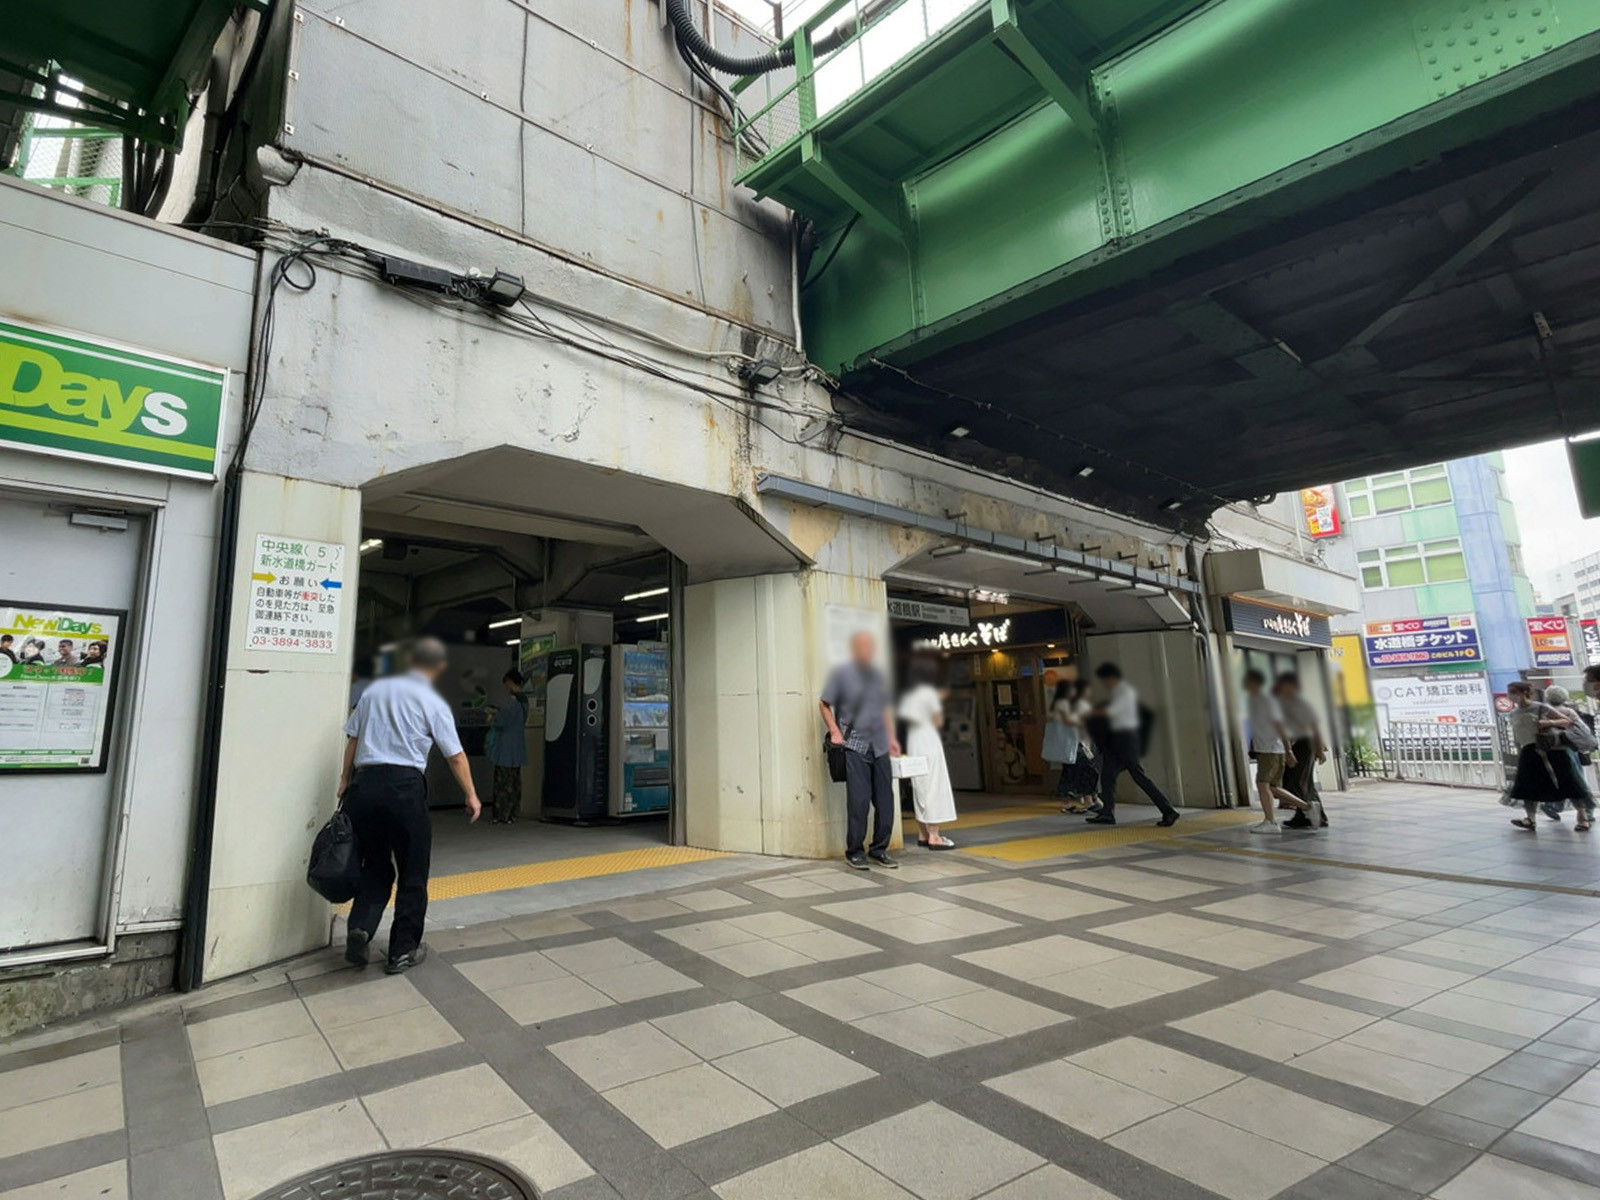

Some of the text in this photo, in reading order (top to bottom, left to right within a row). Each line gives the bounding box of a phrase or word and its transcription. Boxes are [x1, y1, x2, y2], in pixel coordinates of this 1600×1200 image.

[260, 554, 337, 573] 新水道橋ガード
[279, 575, 318, 587] お願い
[257, 586, 335, 603] 自動車等が衝突した
[255, 609, 313, 624] 御連絡下さい。
[251, 635, 333, 649] 03-3894-3833
[1374, 631, 1468, 650] 水道橋チケット
[1394, 683, 1482, 698] CAT矯正歯科
